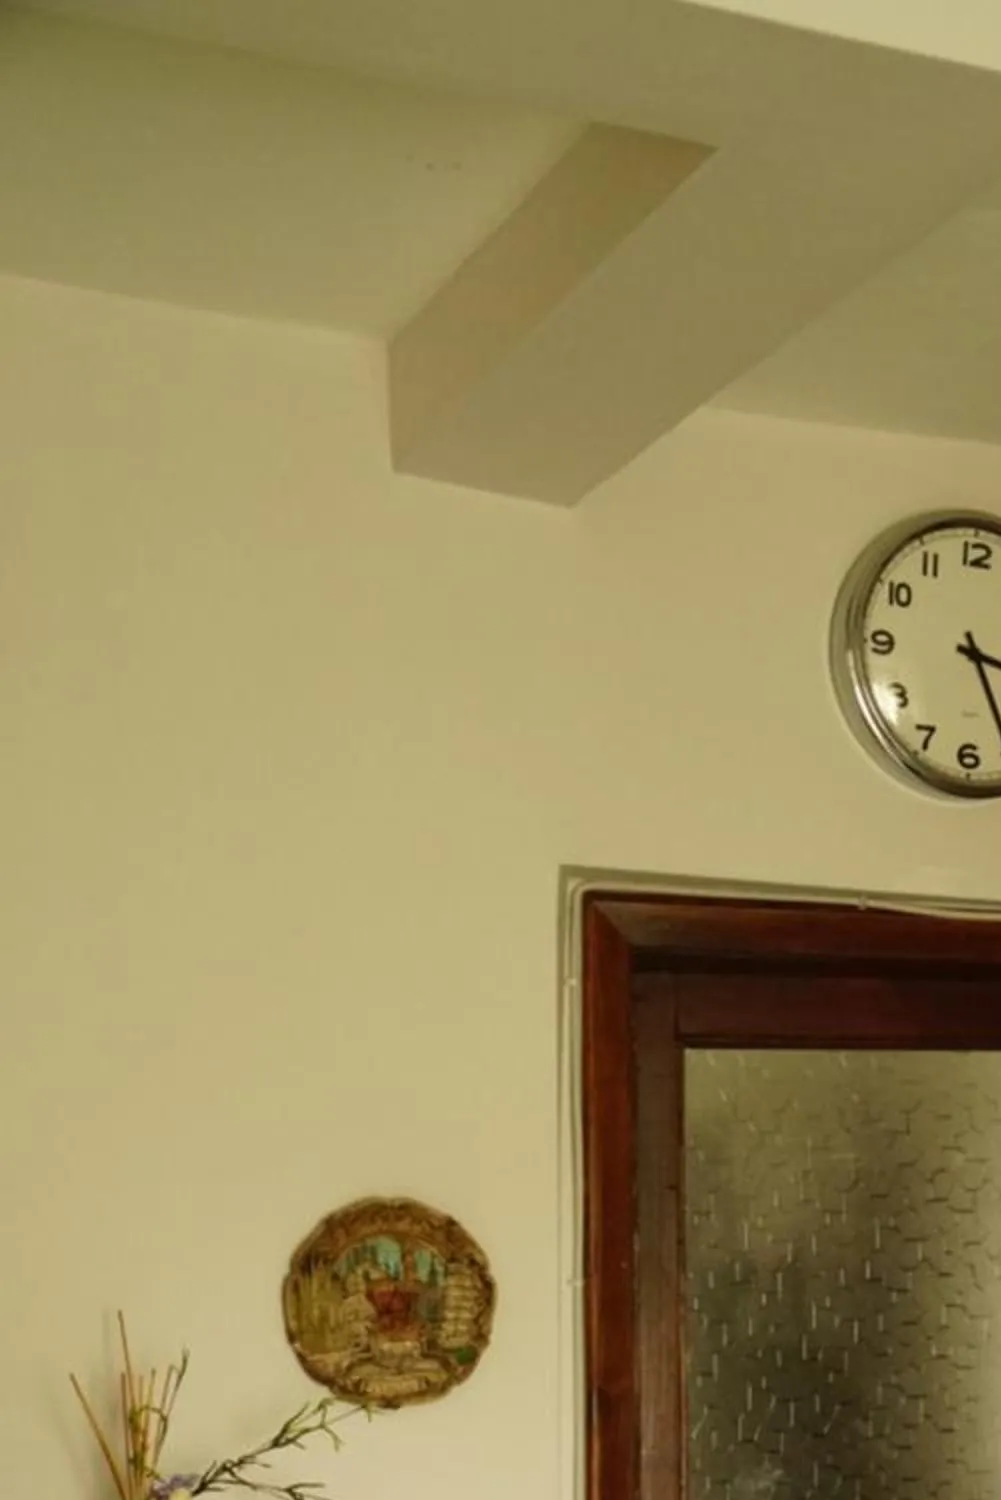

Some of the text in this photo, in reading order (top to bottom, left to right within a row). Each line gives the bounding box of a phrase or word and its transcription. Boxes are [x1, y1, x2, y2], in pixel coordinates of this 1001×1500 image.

[923, 552, 938, 577] 11
[963, 541, 992, 569] 12
[889, 581, 912, 607] 10
[871, 630, 895, 655] 9
[915, 724, 936, 751] 7
[957, 744, 980, 769] 6
